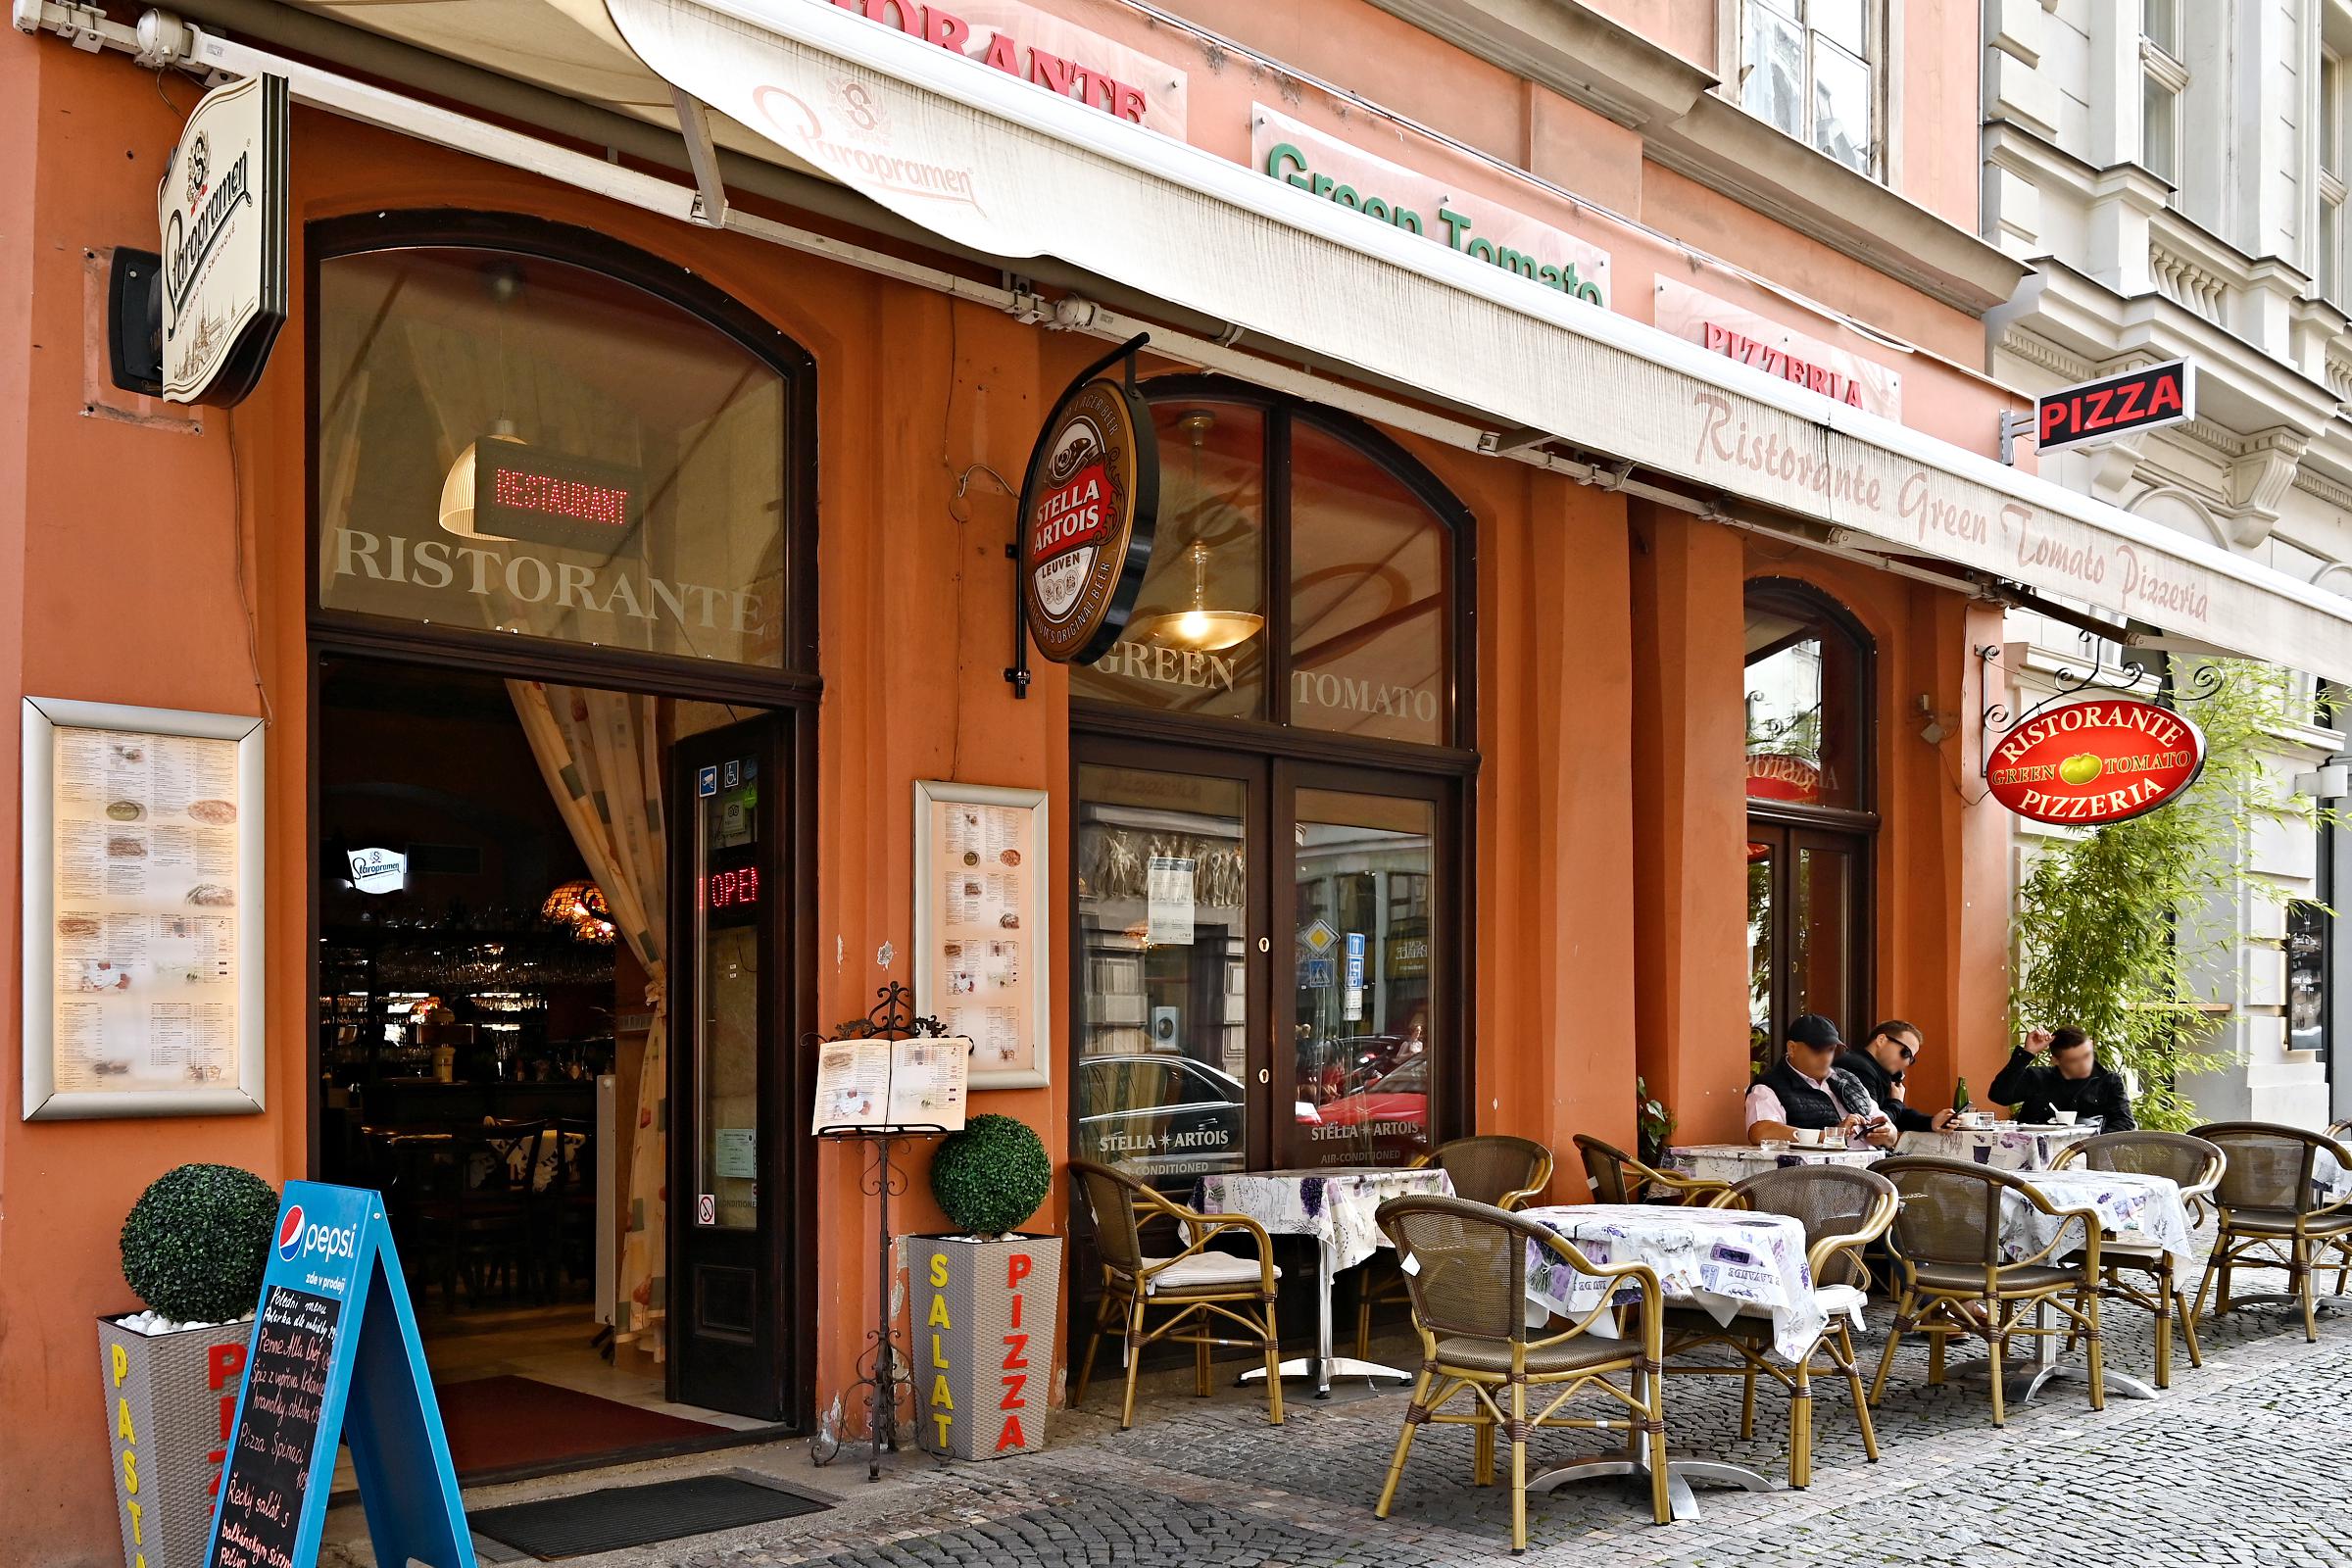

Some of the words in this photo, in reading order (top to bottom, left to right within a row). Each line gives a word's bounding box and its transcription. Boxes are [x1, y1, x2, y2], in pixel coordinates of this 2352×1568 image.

[166, 150, 253, 341] Staropramen
[1704, 321, 1864, 410] PIZZERIA
[1101, 405, 1120, 436] BEER
[2040, 374, 2183, 440] PIZZA
[496, 467, 628, 525] RESTAURANT
[1036, 479, 1100, 527] STELLA
[1693, 392, 1882, 511] Ristorante
[1897, 471, 1988, 546] Green
[2000, 504, 2106, 585] Tomato
[2116, 544, 2210, 623] Pizzeria
[1033, 505, 1100, 555] ARTOIS
[334, 526, 766, 636] RISTORANTE
[1041, 552, 1081, 579] LEUVEN
[1056, 601, 1096, 644] ORIGINAL
[1091, 562, 1110, 601] BEER
[1093, 640, 1236, 693] GREEN
[1293, 669, 1438, 722] TOMATO
[1998, 706, 2184, 765] RISTORANTE
[1992, 764, 2056, 785] GREEN
[2104, 750, 2191, 775] TOMATO
[2018, 777, 2165, 818] PIZZERIA
[352, 857, 402, 880] Staropramen
[1100, 1134, 1155, 1152] STELLA
[1175, 1130, 1229, 1149] ARTOIS
[1311, 1123, 1358, 1142] STELLA
[1373, 1121, 1419, 1137] ARTOIS
[1321, 1150, 1400, 1164] AIR-CONDITIONED
[303, 1223, 356, 1262] pepsi
[306, 1273, 318, 1285] zde
[322, 1276, 346, 1295] prodeji
[305, 1301, 327, 1315] menu
[259, 1327, 284, 1354] Penne
[284, 1332, 303, 1358] Alla
[927, 1253, 954, 1448] SALAT
[995, 1253, 1032, 1452] PIZZA
[238, 1422, 267, 1452] Pizza
[256, 1491, 282, 1521] salát
[280, 1512, 290, 1528] s
